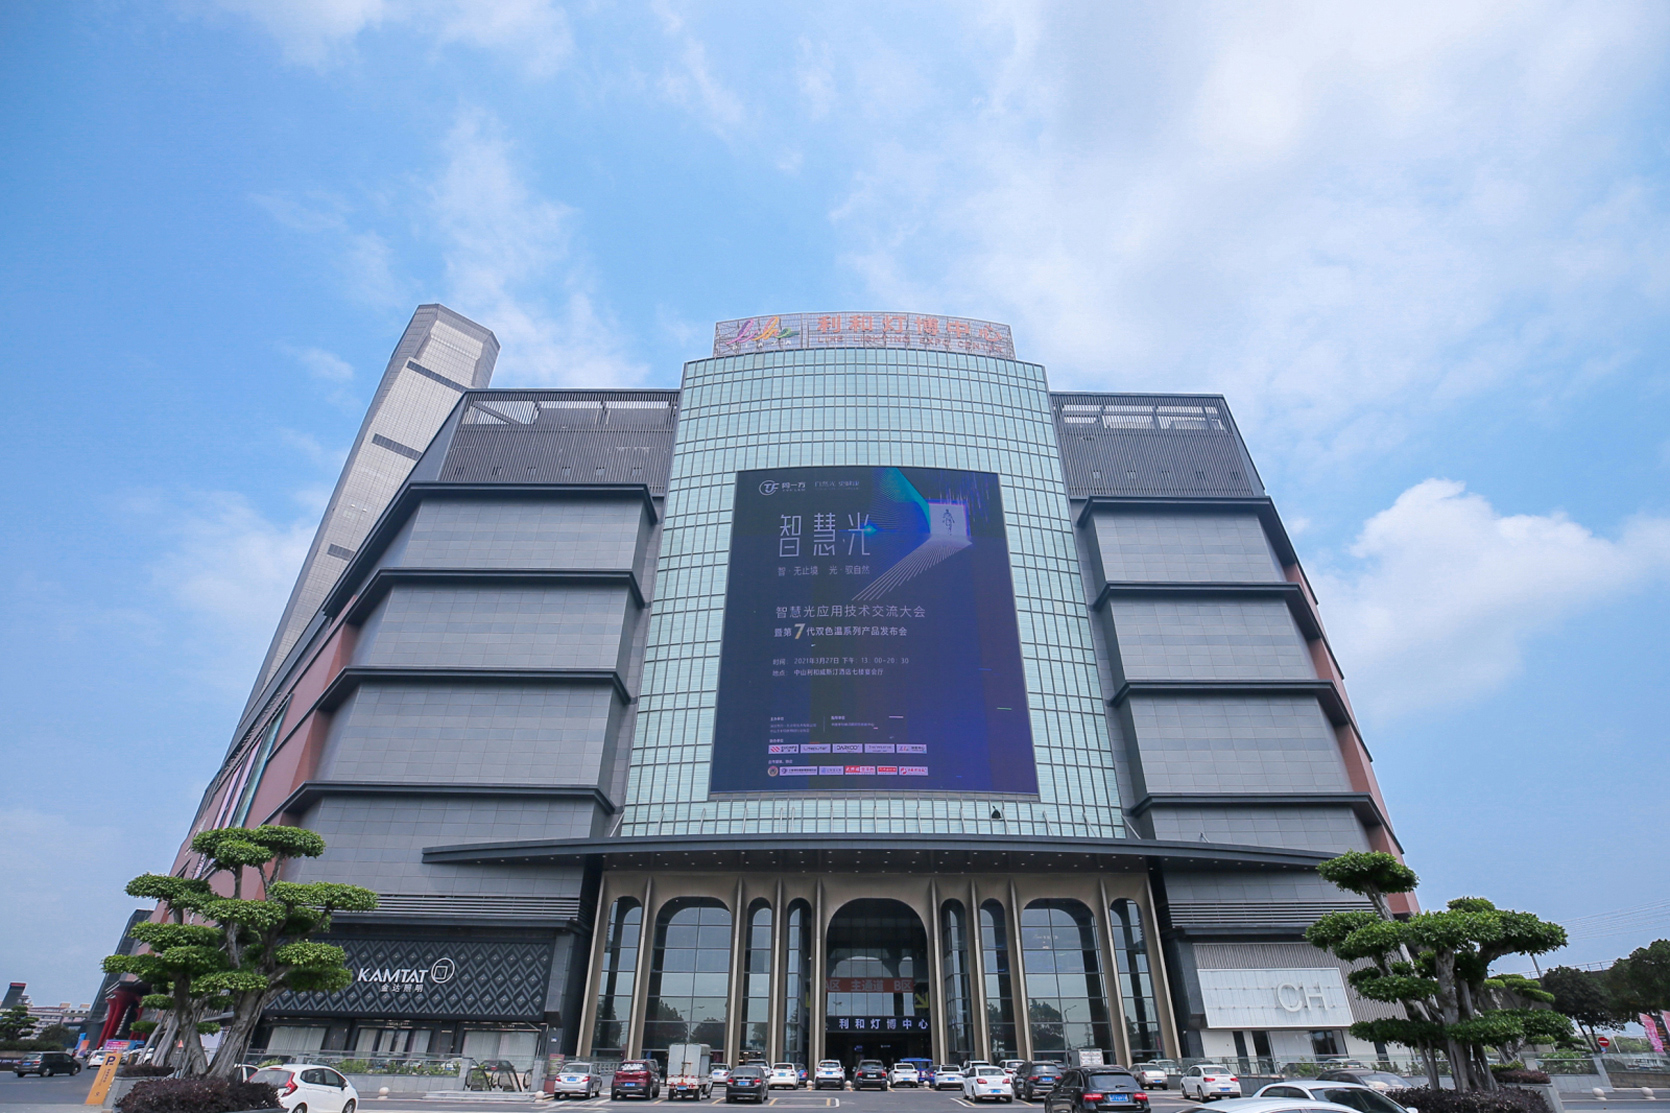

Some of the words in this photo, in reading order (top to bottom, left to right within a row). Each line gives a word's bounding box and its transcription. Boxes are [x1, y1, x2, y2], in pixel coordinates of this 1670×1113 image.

[816, 314, 1002, 342] 利和灯博中心
[853, 335, 910, 344] LIGHTING
[919, 337, 950, 348] EXPO
[957, 340, 1004, 353] CENTER
[779, 512, 871, 557] 智慧光
[775, 604, 926, 619] 智慧光应用技术交流大会
[357, 968, 429, 983] KAMTAT
[850, 979, 884, 991] 主通道
[894, 979, 913, 991] B区
[1276, 981, 1329, 1013] CH
[838, 1018, 929, 1030] 利和灯博中心
